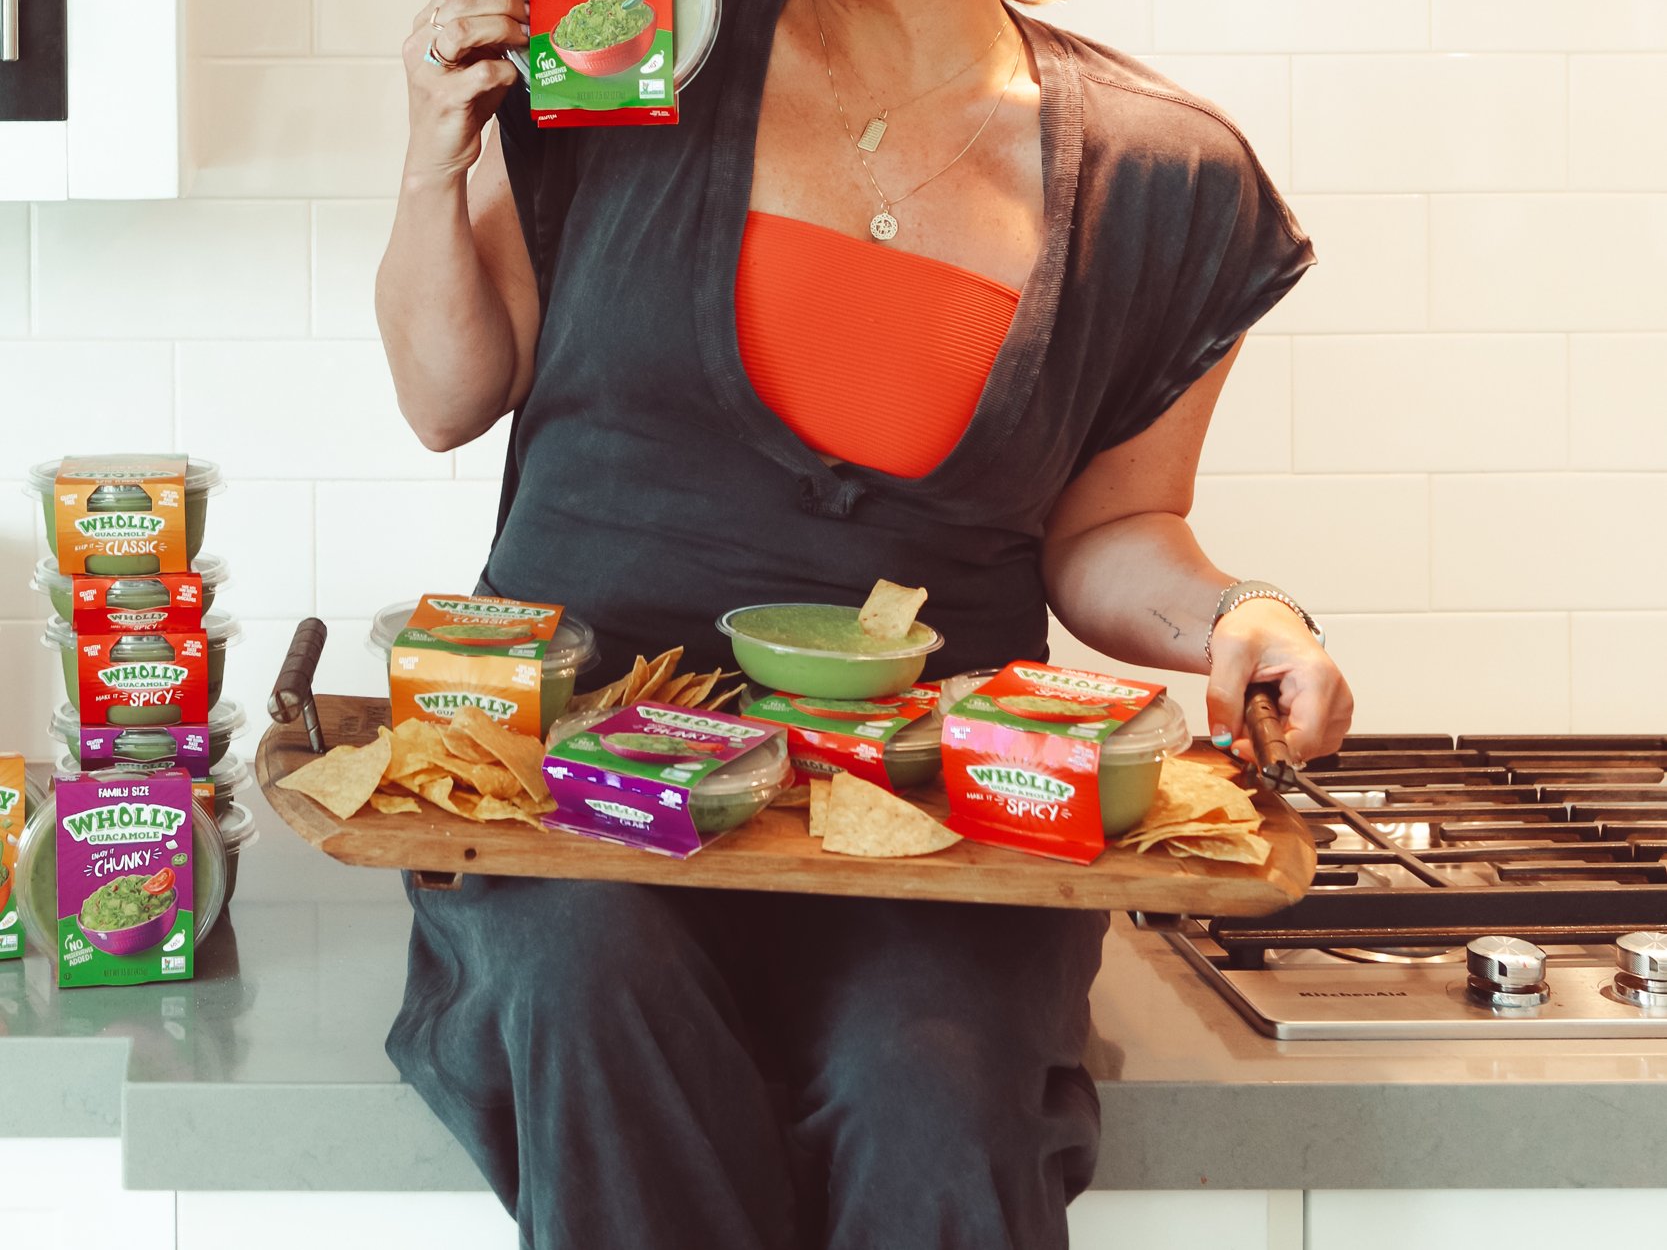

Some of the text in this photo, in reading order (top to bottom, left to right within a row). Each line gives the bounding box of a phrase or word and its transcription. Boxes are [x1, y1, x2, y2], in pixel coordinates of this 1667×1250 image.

[541, 58, 556, 70] NO
[541, 74, 566, 87] ADDED!
[78, 514, 162, 533] WHOLLY
[106, 540, 158, 556] CLASSIC
[110, 612, 168, 621] WHOLLY
[434, 600, 550, 617] WHOLLY
[134, 622, 158, 630] SPICY
[453, 617, 514, 625] CLASSIC
[102, 665, 185, 684] WHOLLY
[1020, 668, 1144, 697] WHOLLY
[130, 689, 174, 707] SPICY
[418, 694, 515, 716] WHOLLY
[643, 709, 752, 736] WHOLLY
[972, 768, 1072, 798] WHOLLY
[98, 786, 150, 798] FAMILY SIZE
[1006, 798, 1059, 822] SPICY
[68, 806, 182, 836] WHOLLY
[90, 831, 160, 842] GUACAMOLE
[92, 850, 108, 860] ENJOY
[94, 848, 150, 877] CHUNKY
[69, 938, 84, 952] NO
[69, 954, 92, 966] ADDED!
